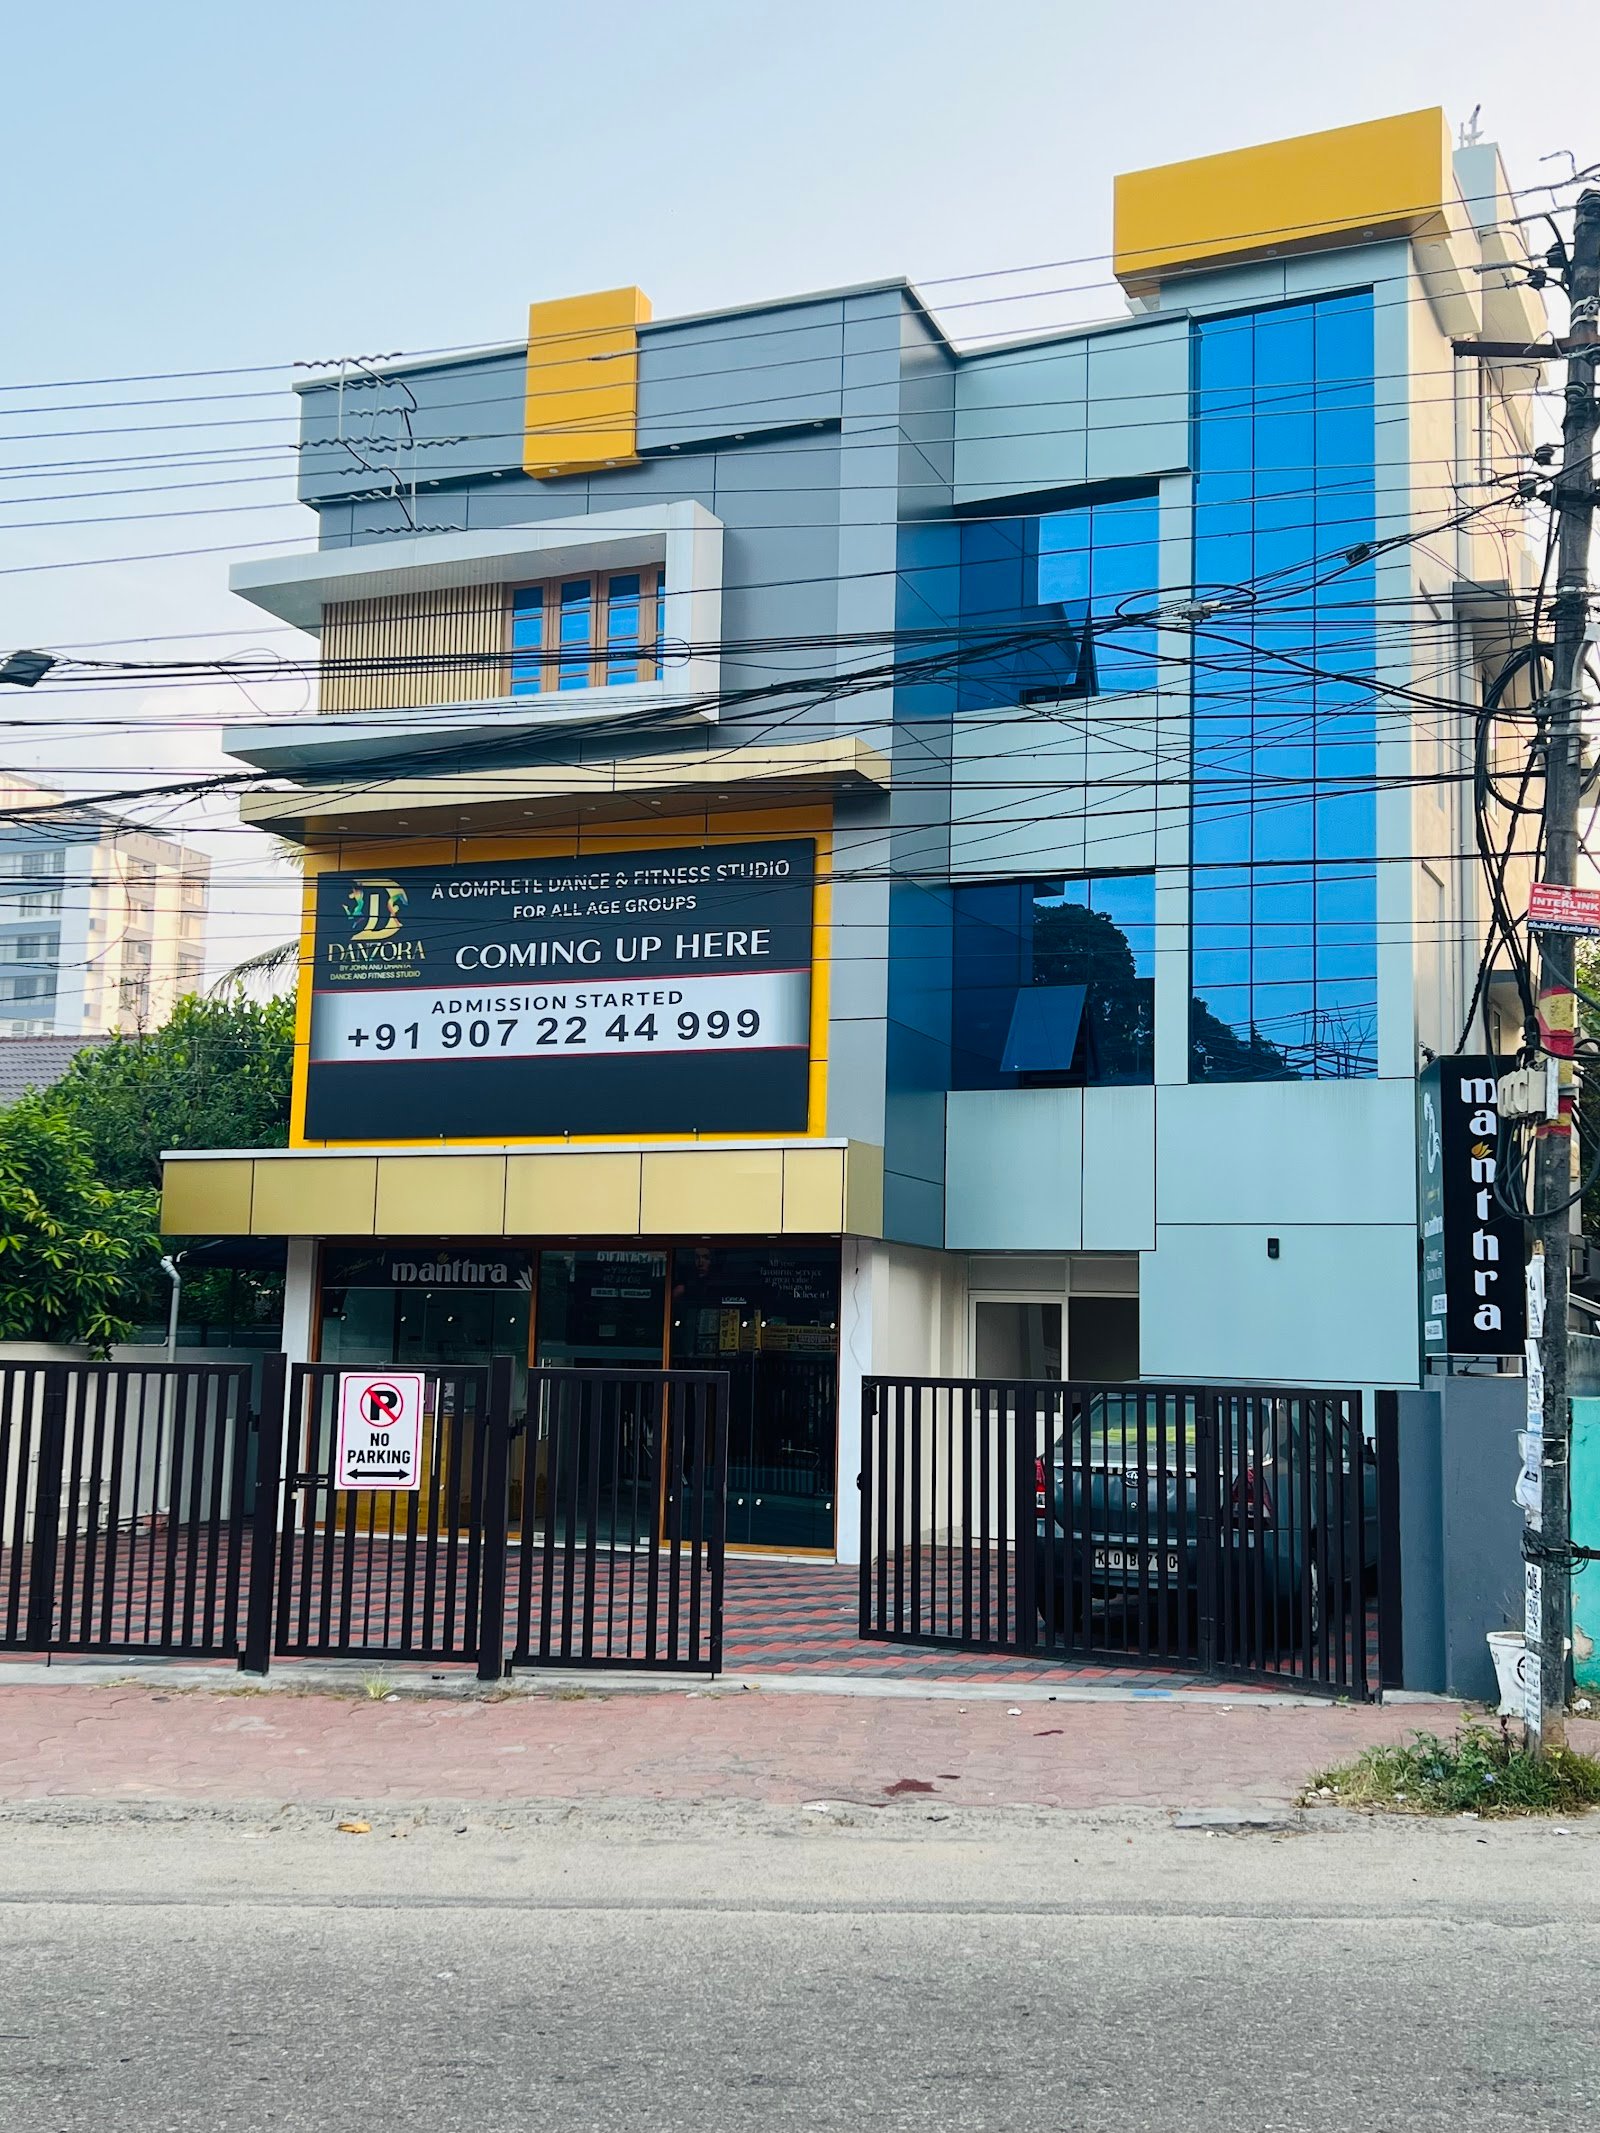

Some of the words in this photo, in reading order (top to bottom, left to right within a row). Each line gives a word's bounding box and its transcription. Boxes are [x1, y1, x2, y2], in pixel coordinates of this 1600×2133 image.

[431, 884, 444, 900] A
[449, 878, 544, 899] COMPLETE
[548, 873, 611, 892] DANCE
[615, 871, 629, 889] &
[633, 866, 711, 885] FITNESS
[716, 859, 790, 882] STUDIO
[513, 903, 547, 919] FOR
[551, 901, 582, 918] ALL
[586, 899, 621, 916] AGE
[625, 895, 697, 913] GROUPS
[1531, 896, 1600, 911] INTERLINK
[327, 940, 426, 963] DANZORA
[455, 938, 601, 970] COMING
[615, 935, 662, 963] UP
[675, 928, 771, 960] HERE
[330, 972, 352, 981] DANCE
[353, 972, 367, 980] AND
[367, 971, 395, 980] FITNESS
[395, 970, 421, 978] STUDIO
[431, 995, 567, 1014] ADMISSION
[575, 990, 684, 1009] STARTED
[348, 1021, 420, 1050] +91
[441, 1018, 519, 1048] 907
[536, 1016, 587, 1045] 22
[605, 1013, 659, 1042] 44
[676, 1009, 761, 1040] 999
[1460, 1077, 1502, 1331] manthra
[391, 1258, 508, 1283] manthra
[370, 1433, 390, 1446] NO
[347, 1450, 411, 1464] PARKING
